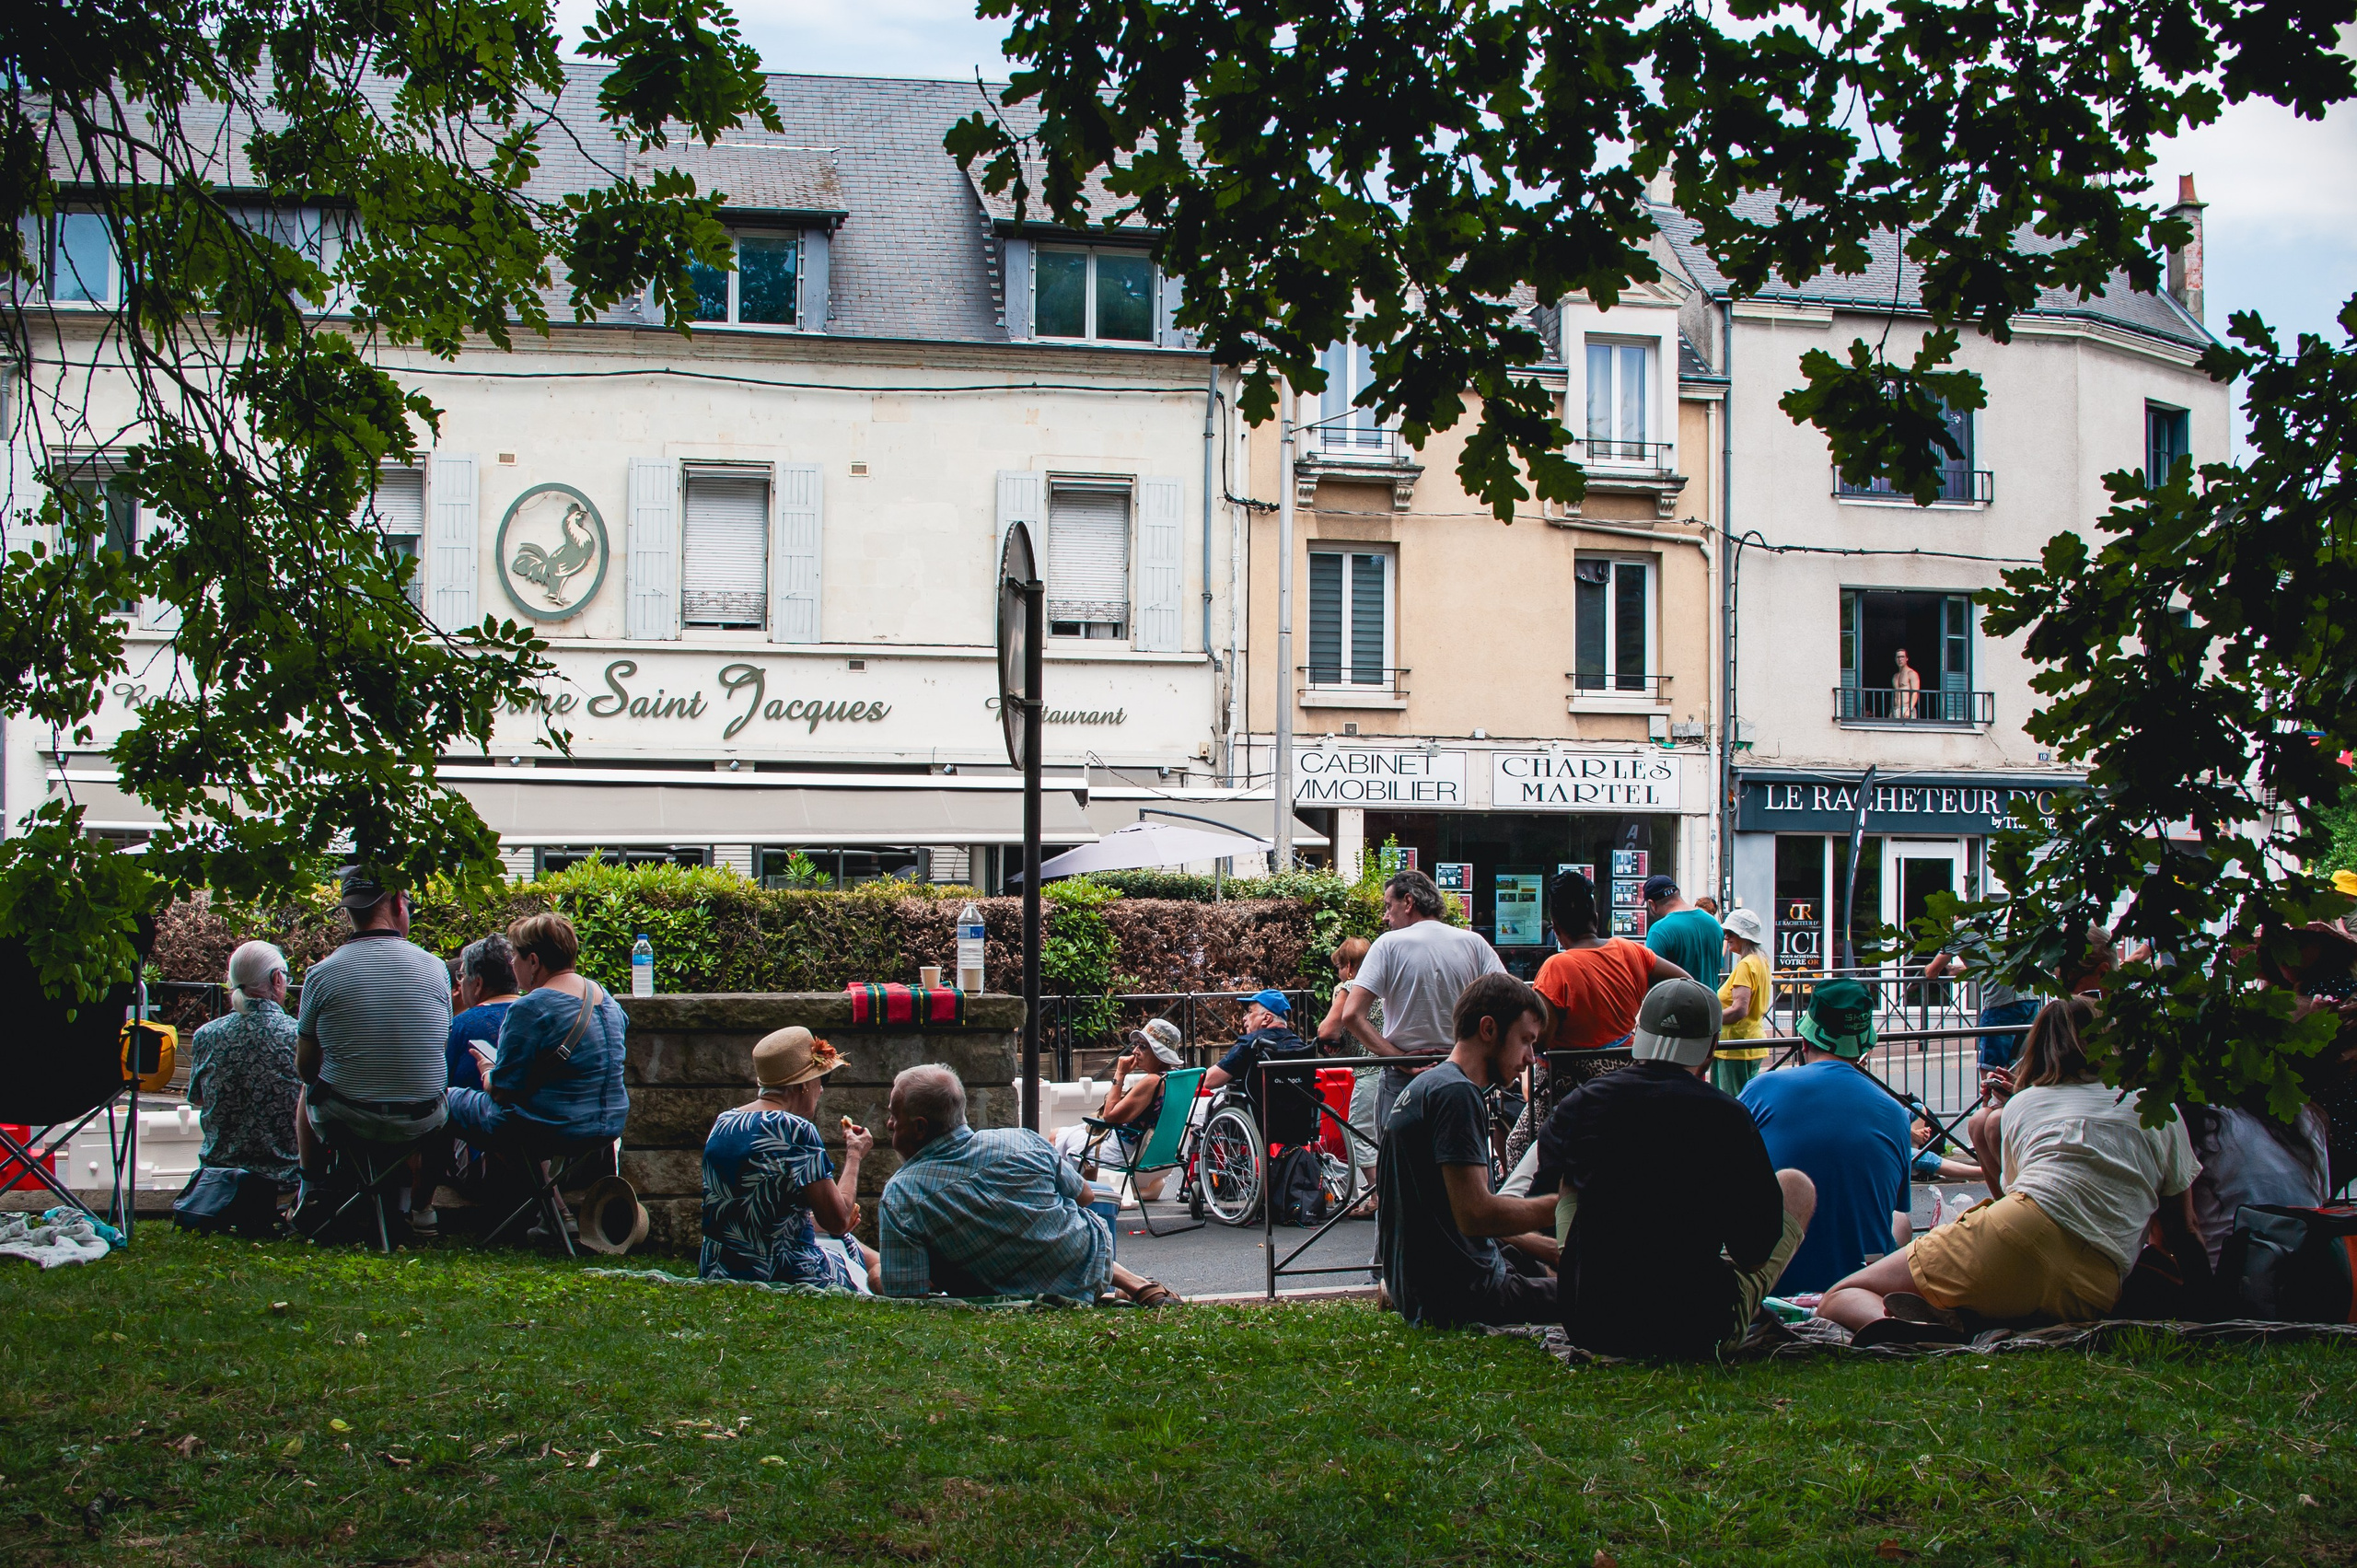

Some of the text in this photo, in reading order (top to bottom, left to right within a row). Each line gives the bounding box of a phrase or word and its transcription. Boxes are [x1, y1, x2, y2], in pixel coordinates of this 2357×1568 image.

[586, 659, 708, 719] Saint
[718, 663, 892, 740] Jacques
[984, 696, 1128, 726] taurant
[1300, 752, 1438, 775] CABINET
[1502, 757, 1672, 781] CHARLES
[1295, 779, 1457, 802] MMOBILIER
[1520, 783, 1659, 805] MARTEL
[1764, 784, 1804, 810] LE
[2007, 789, 2076, 816] D'O
[1991, 816, 2003, 829] by
[1781, 931, 1819, 955] ICI
